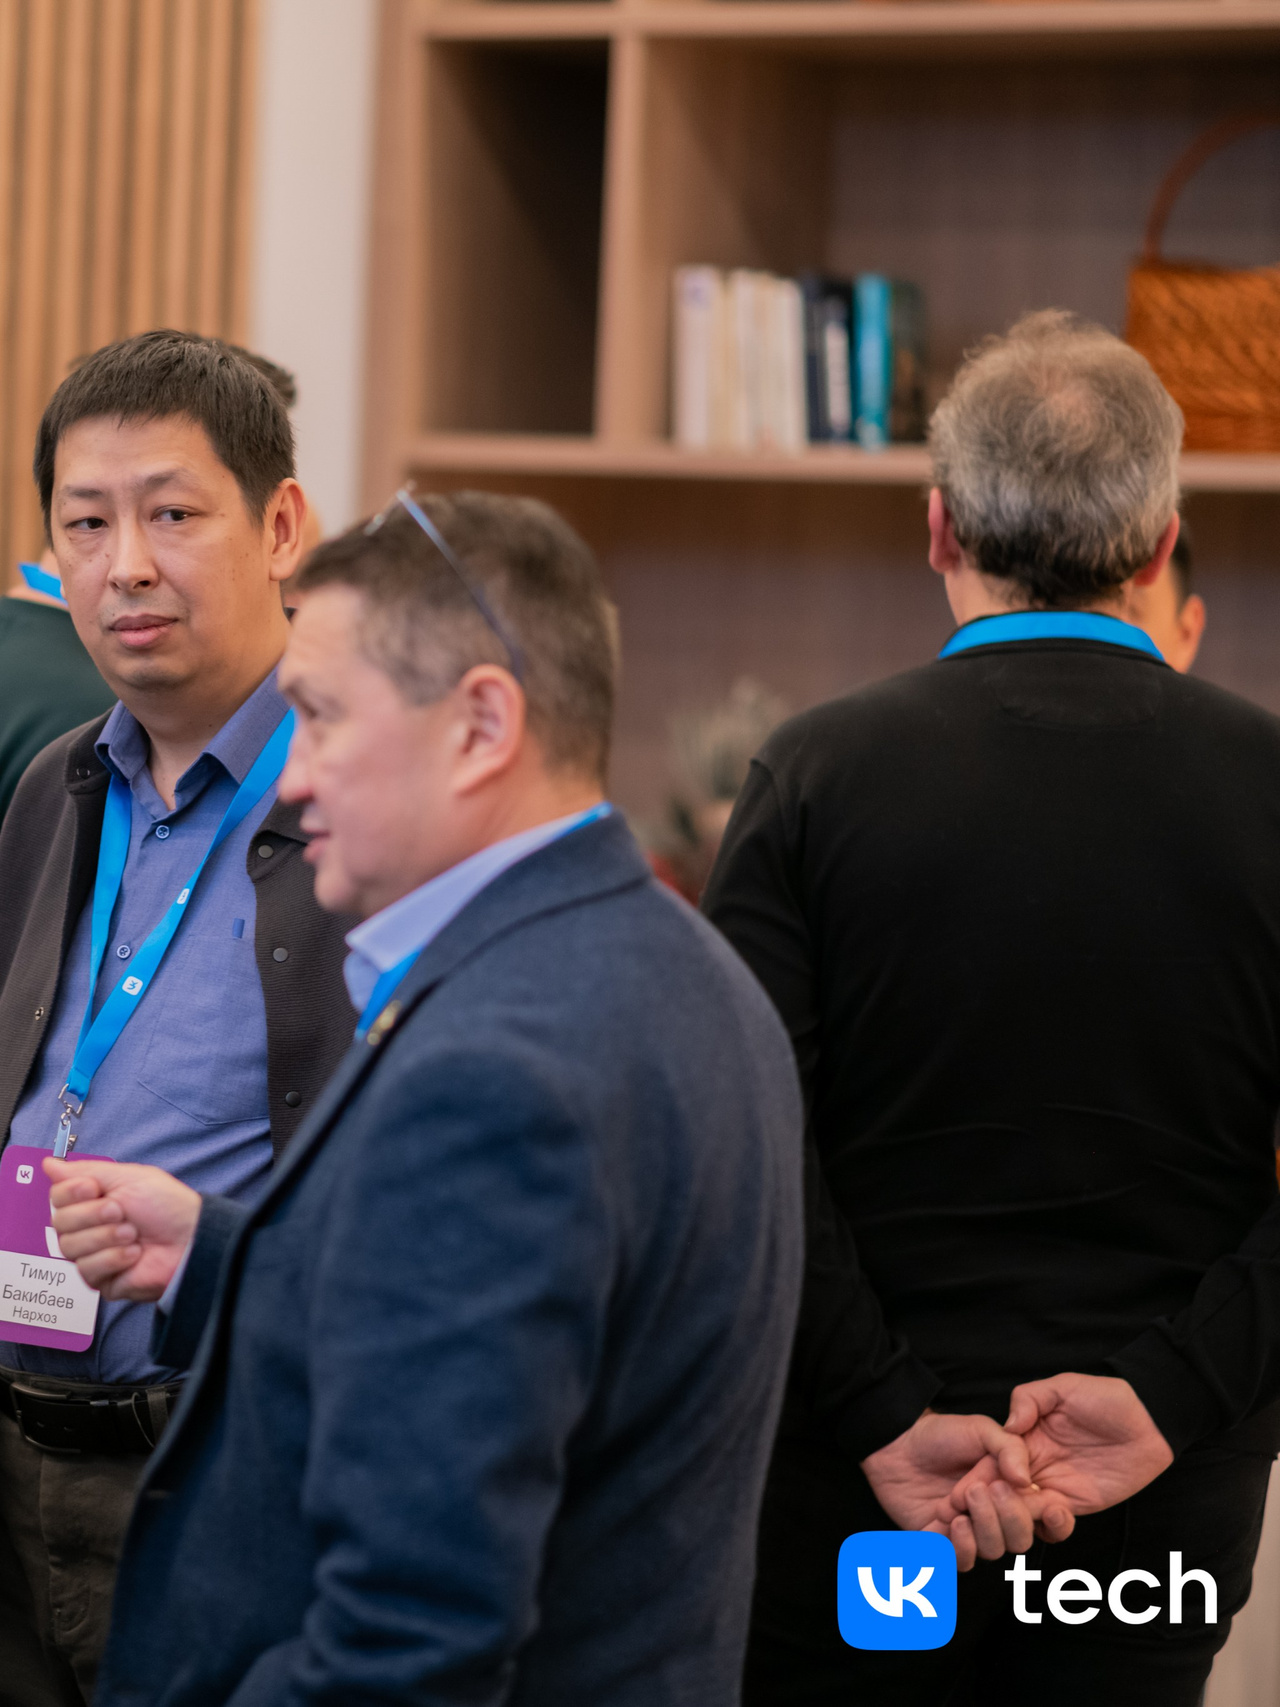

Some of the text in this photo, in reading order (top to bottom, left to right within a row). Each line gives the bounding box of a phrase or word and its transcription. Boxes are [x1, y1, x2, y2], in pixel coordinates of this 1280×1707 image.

[21, 1262, 66, 1287] Тимур
[2, 1284, 74, 1309] Бакибаев
[12, 1305, 58, 1324] Нархоз
